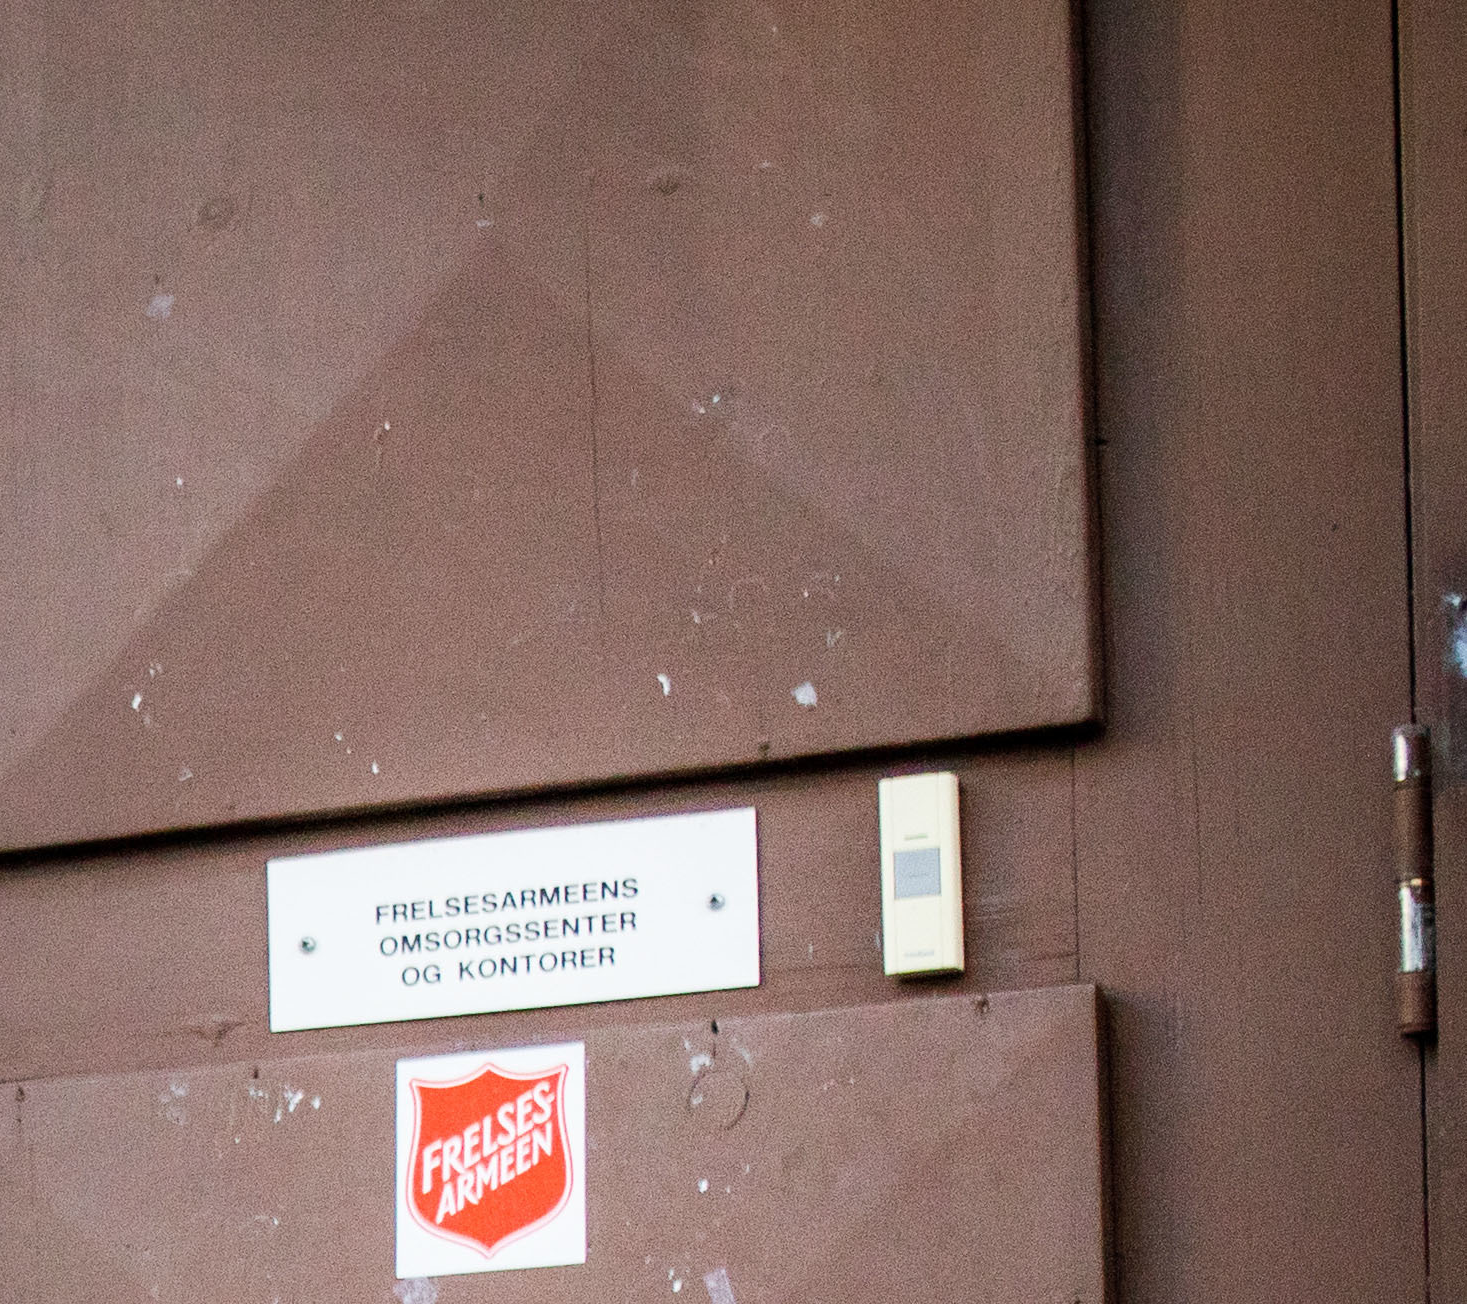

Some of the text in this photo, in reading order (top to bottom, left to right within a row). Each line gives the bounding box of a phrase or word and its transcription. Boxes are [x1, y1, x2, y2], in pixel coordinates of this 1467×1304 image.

[376, 878, 639, 924] FRELSESARMEENS
[380, 911, 637, 956] OMSORGSSENTER
[402, 947, 616, 986] OG KONTORER
[422, 1080, 555, 1195] FRELSES-
[436, 1121, 553, 1225] ARMEEN
